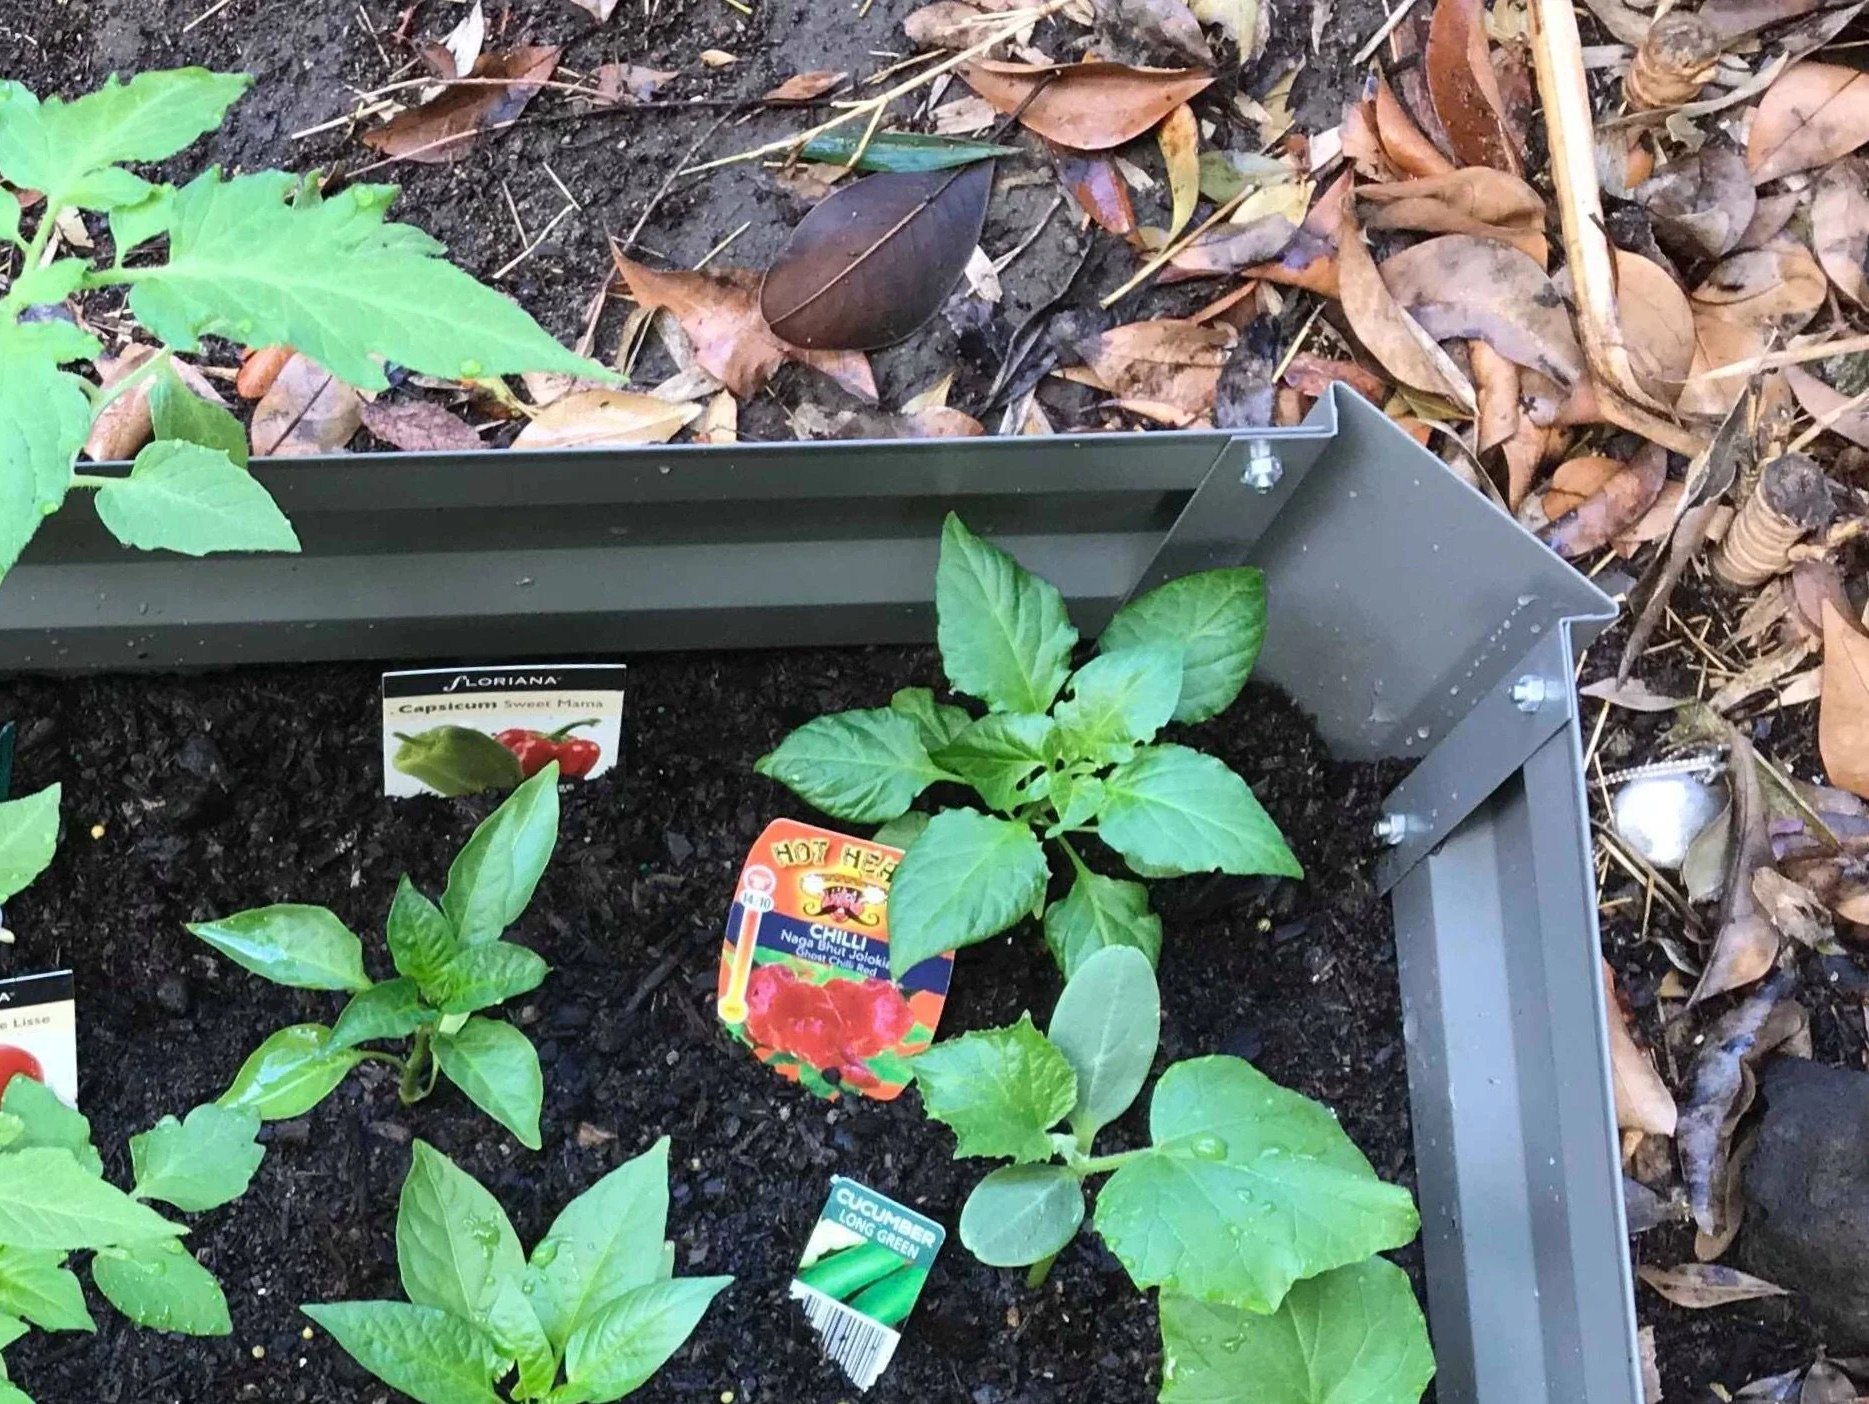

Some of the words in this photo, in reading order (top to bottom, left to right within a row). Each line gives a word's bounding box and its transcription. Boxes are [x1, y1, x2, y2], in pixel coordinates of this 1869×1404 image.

[398, 700, 497, 714] Capsicum
[504, 699, 551, 710] Sweet
[557, 699, 604, 709] Mama
[772, 839, 829, 866] HOT
[843, 845, 898, 884] HEA
[781, 929, 814, 948] Naga
[818, 940, 846, 957] Bhut
[810, 924, 867, 951] CHILLI
[796, 946, 826, 962] Ghost
[857, 963, 878, 977] Red
[13, 1015, 51, 1029] Lisse
[837, 1188, 936, 1248] CUCUMBER
[839, 1209, 874, 1238] LONG
[877, 1228, 920, 1260] GREEN
